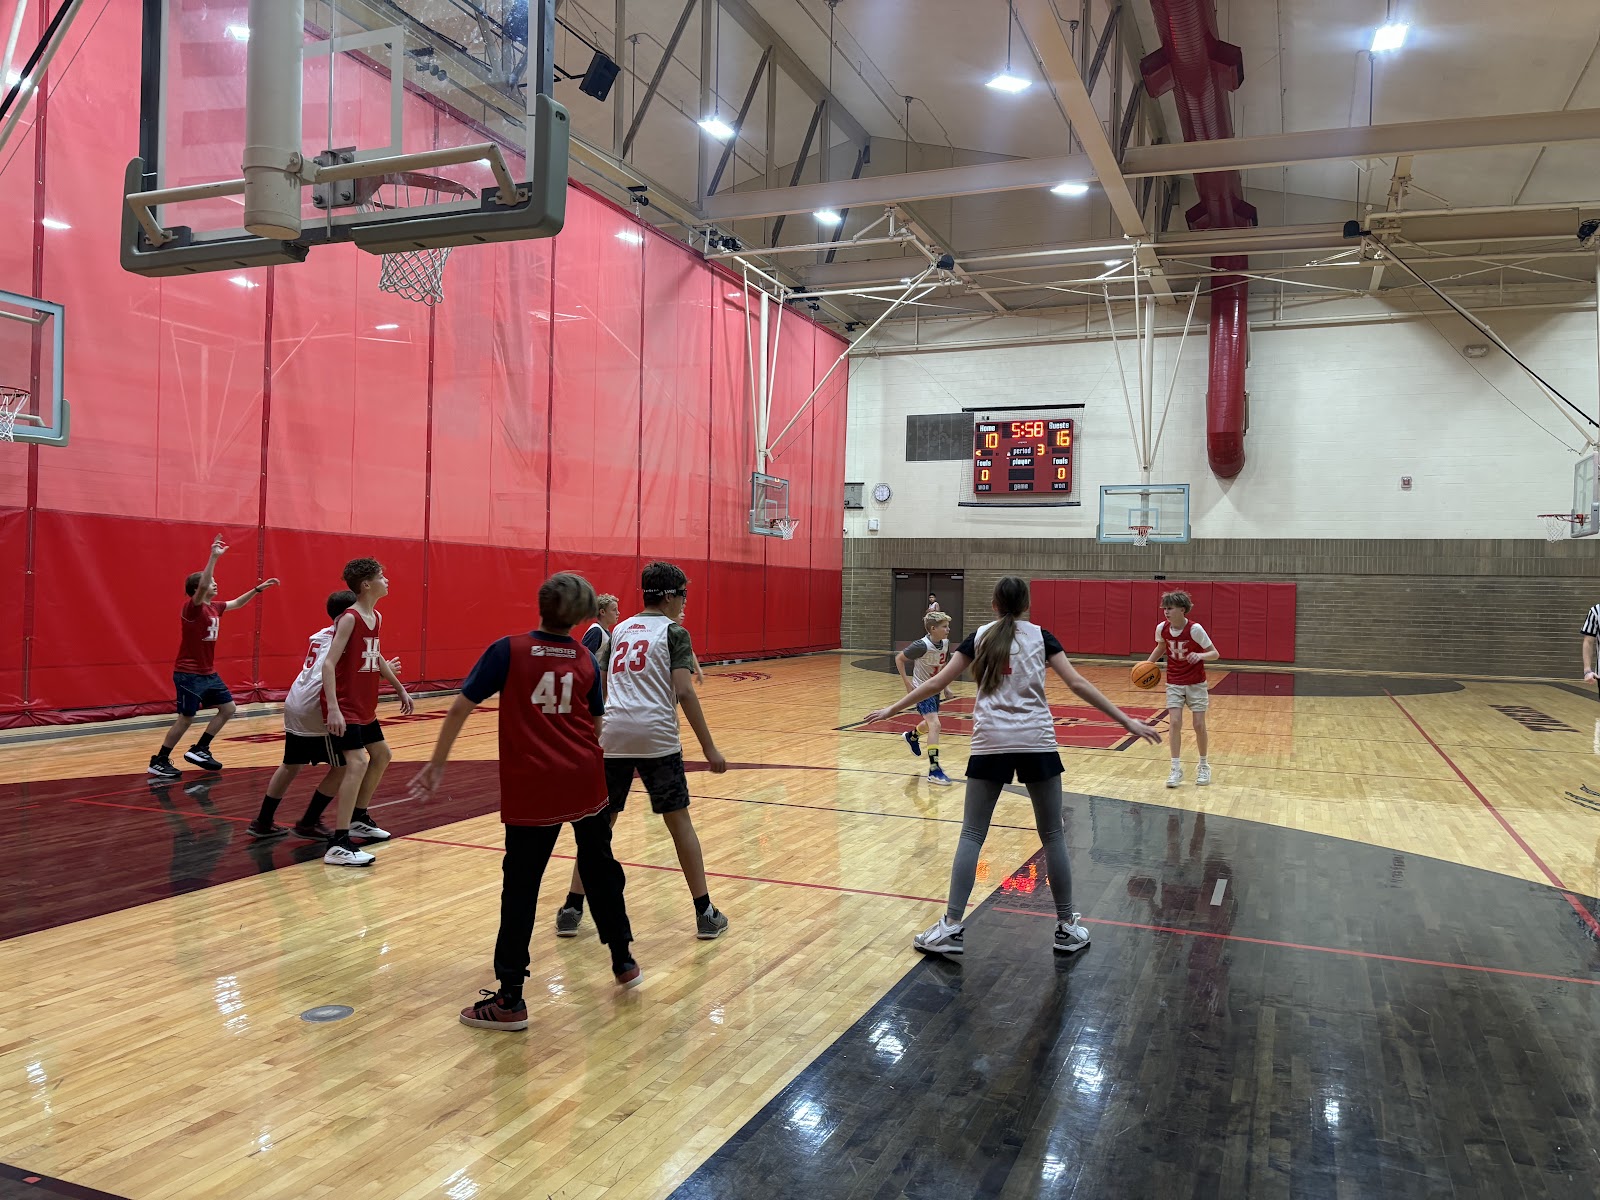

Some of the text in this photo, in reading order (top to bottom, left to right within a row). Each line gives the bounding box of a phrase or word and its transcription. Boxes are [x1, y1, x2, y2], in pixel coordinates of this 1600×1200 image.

[1012, 422, 1044, 438] 5:58
[1056, 430, 1070, 446] 16
[985, 432, 998, 448] 10
[1037, 444, 1044, 456] 3
[982, 470, 988, 480] 0
[1058, 468, 1065, 479] 0
[612, 640, 650, 674] 23
[530, 672, 574, 714] 41
